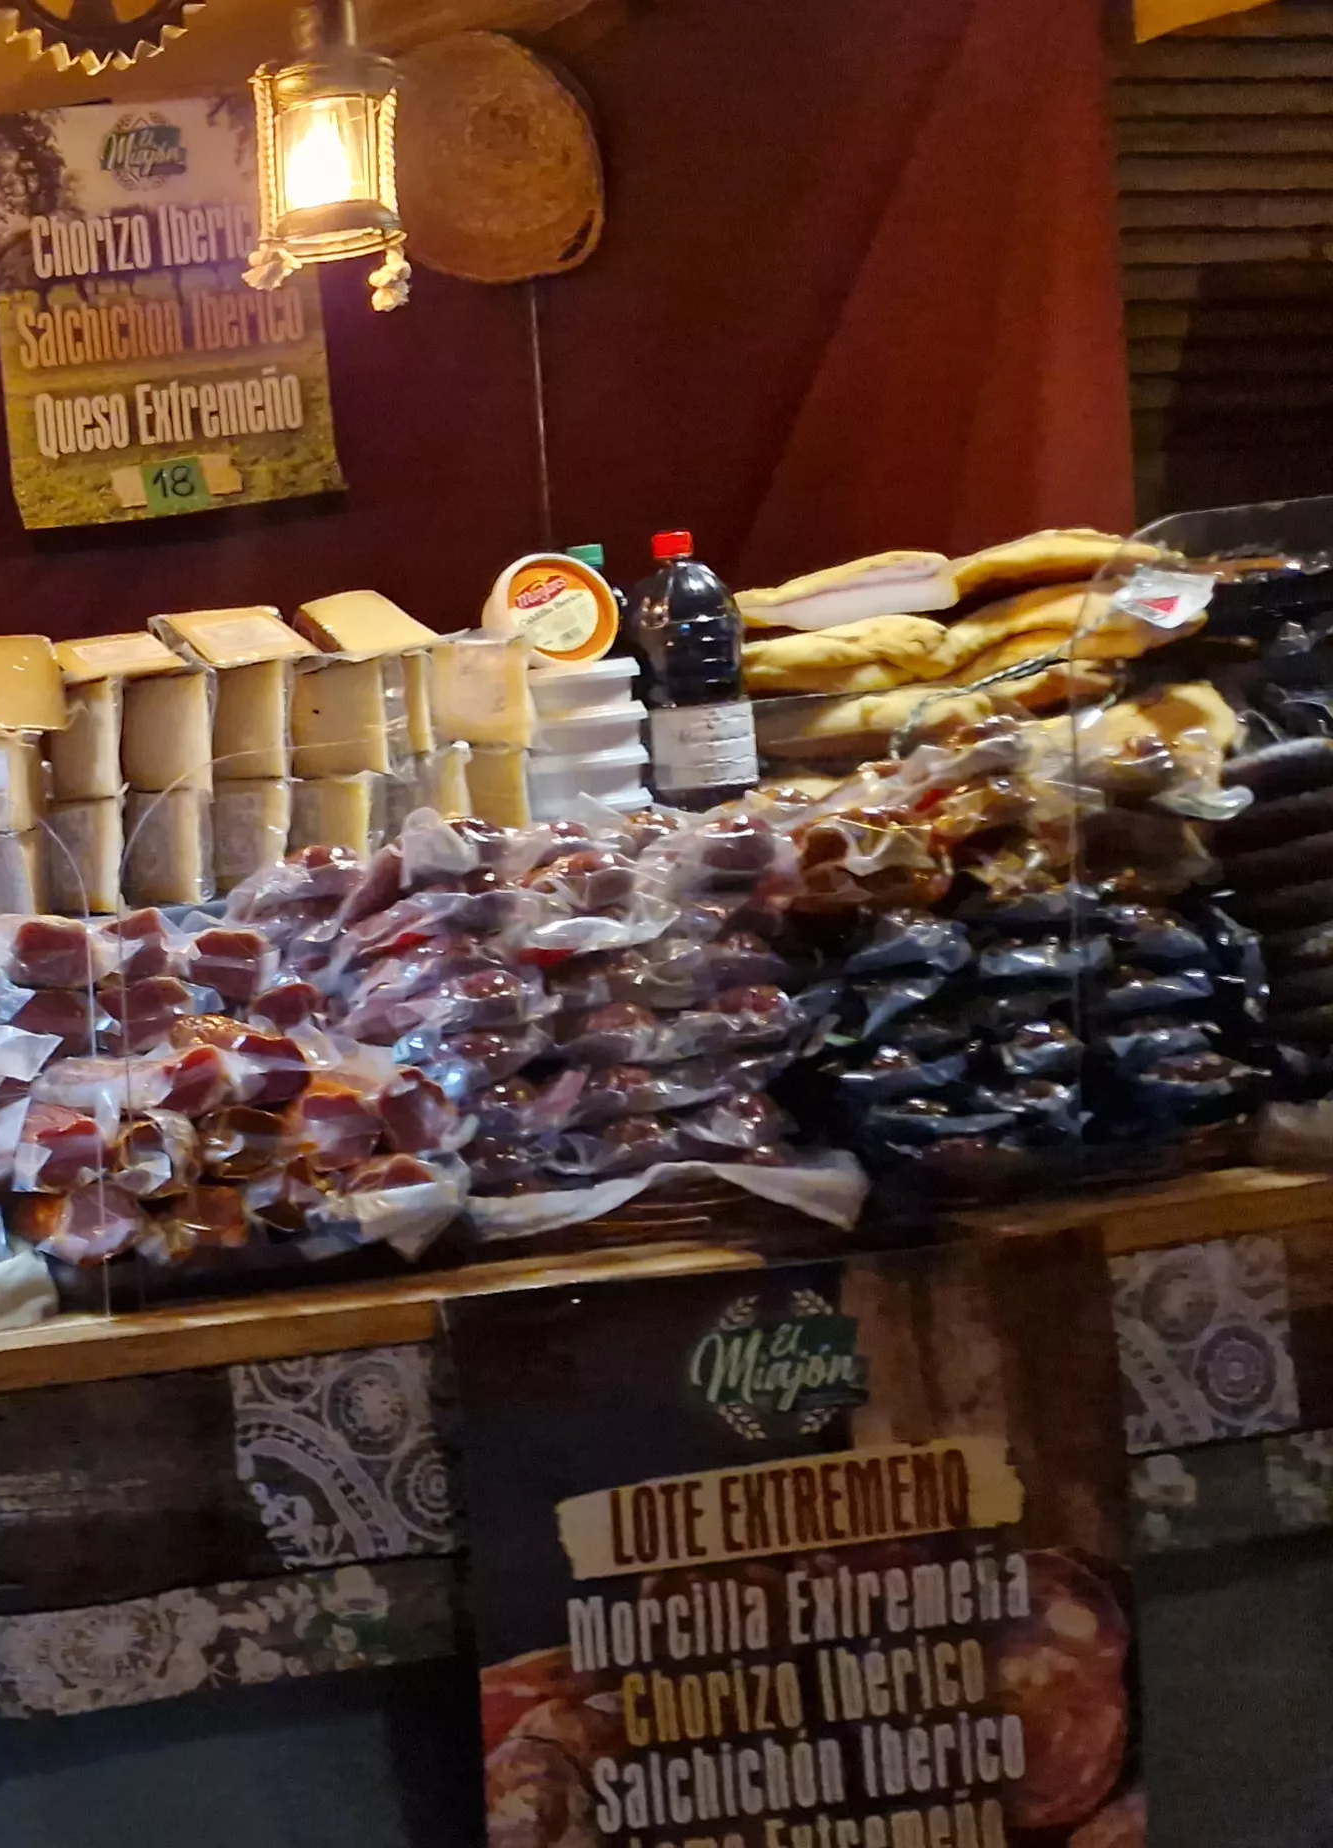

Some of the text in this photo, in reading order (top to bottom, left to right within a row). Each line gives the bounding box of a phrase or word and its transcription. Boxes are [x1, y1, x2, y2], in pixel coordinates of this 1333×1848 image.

[30, 214, 151, 279] Chorizo
[34, 367, 304, 459] Queso Extremeño
[153, 464, 195, 499] 18
[691, 1328, 856, 1412] Miajón
[771, 1323, 804, 1357] El
[610, 1481, 706, 1567] LOTE
[567, 1545, 1032, 1673] Morcilla Extremeña
[623, 1638, 985, 1748] Chorizo Ibérico
[592, 1711, 1026, 1834] Salchichón Ibérico
